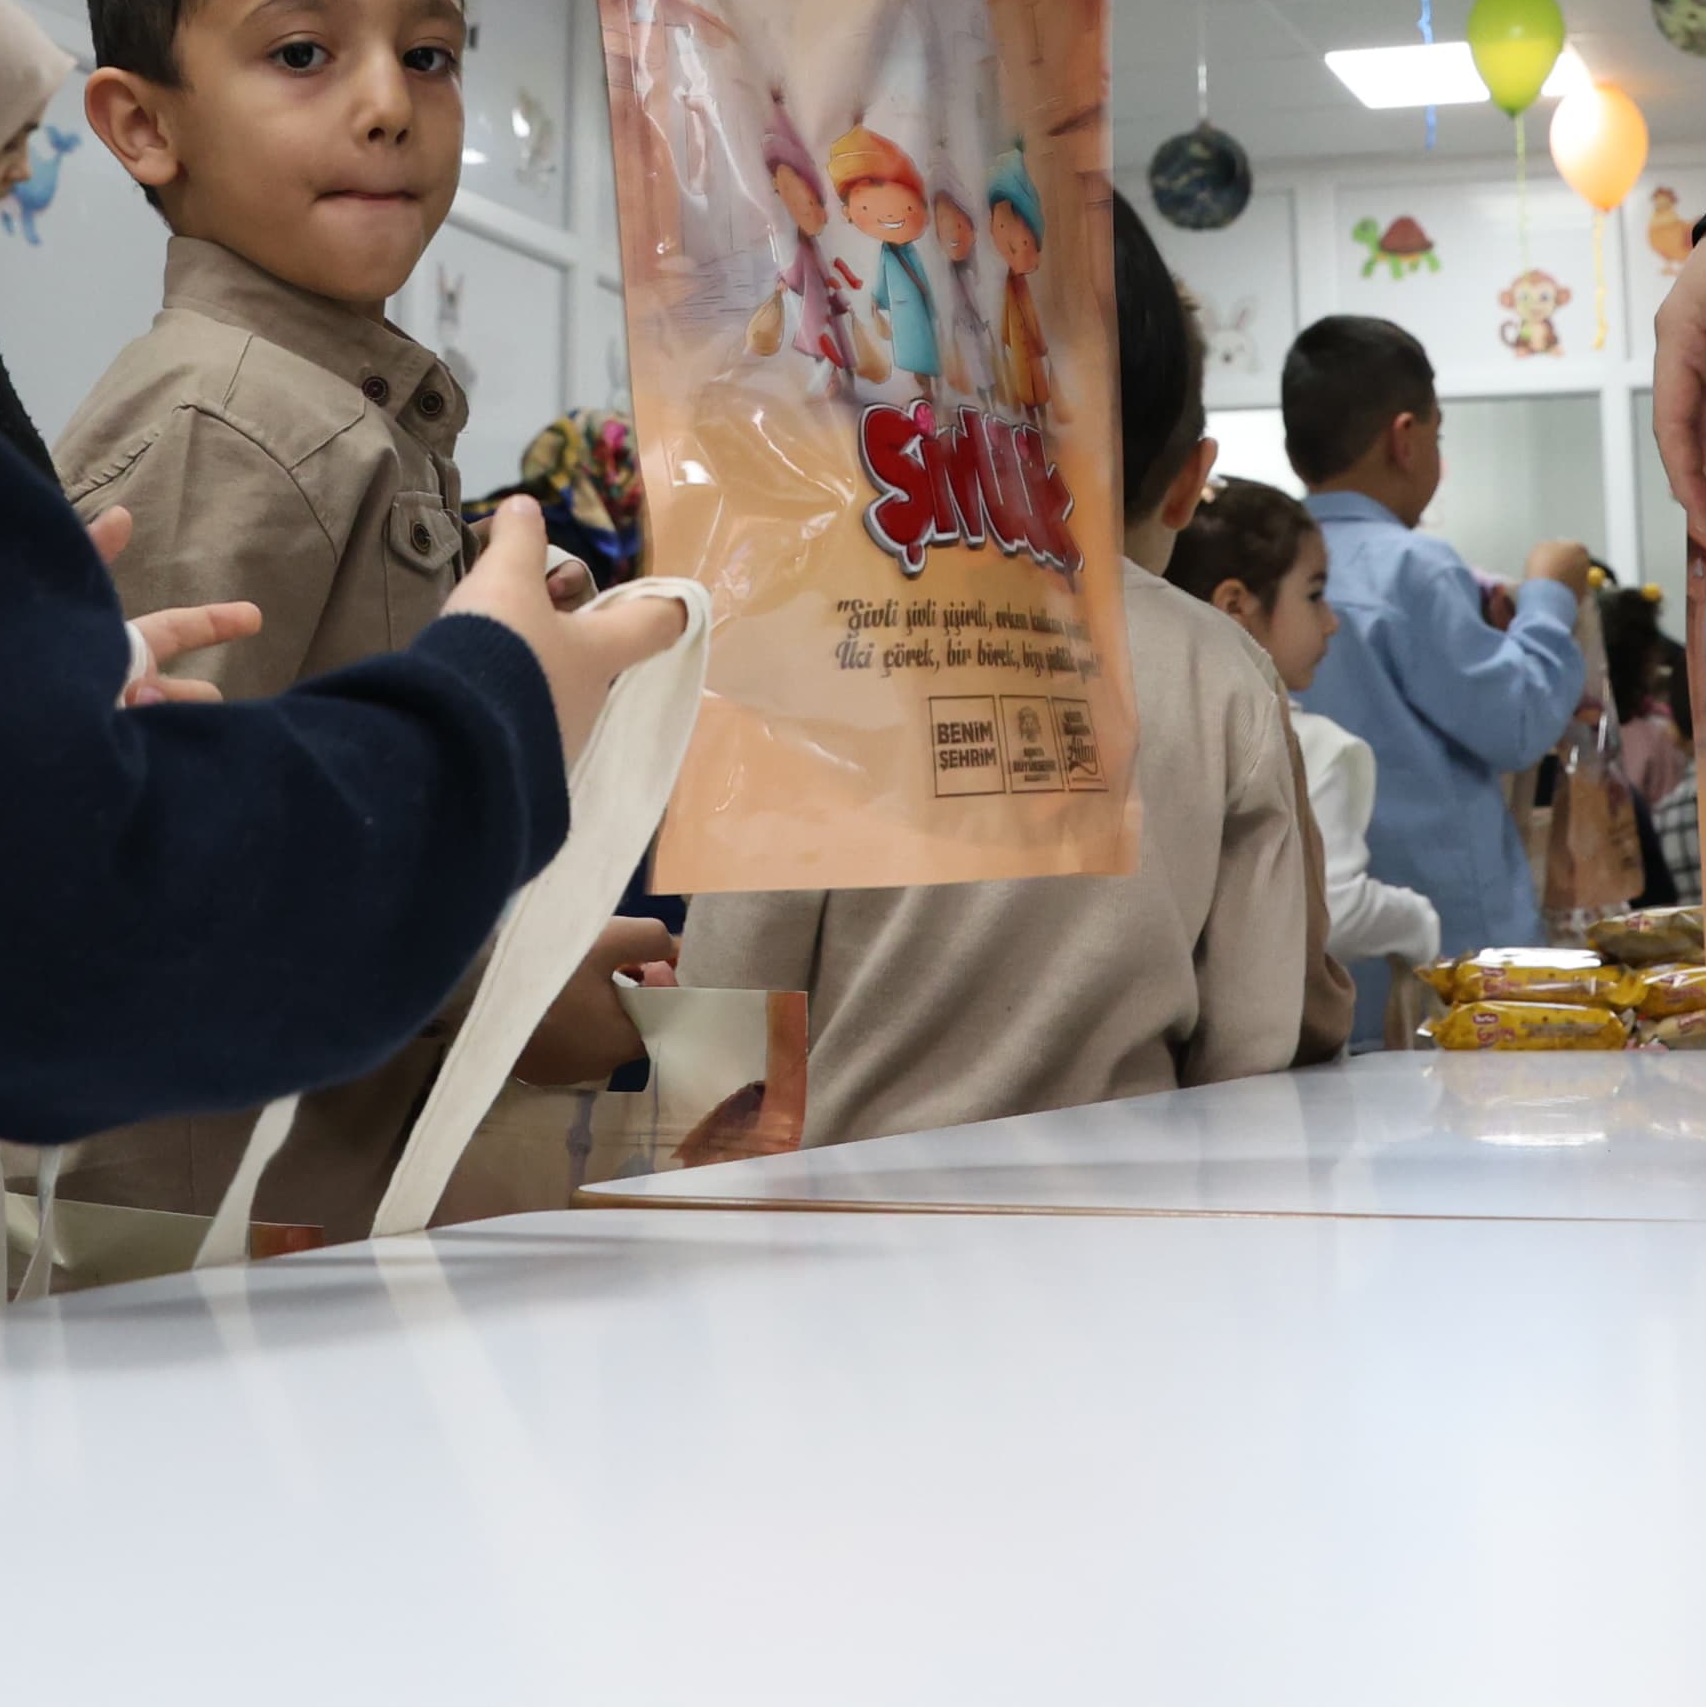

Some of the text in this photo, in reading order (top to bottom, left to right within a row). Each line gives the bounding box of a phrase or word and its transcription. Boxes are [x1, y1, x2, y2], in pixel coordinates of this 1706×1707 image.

[881, 639, 940, 677] çörek,
[947, 638, 972, 667] bir
[937, 720, 994, 744] BENİM
[939, 748, 997, 772] ŞEHRİM
